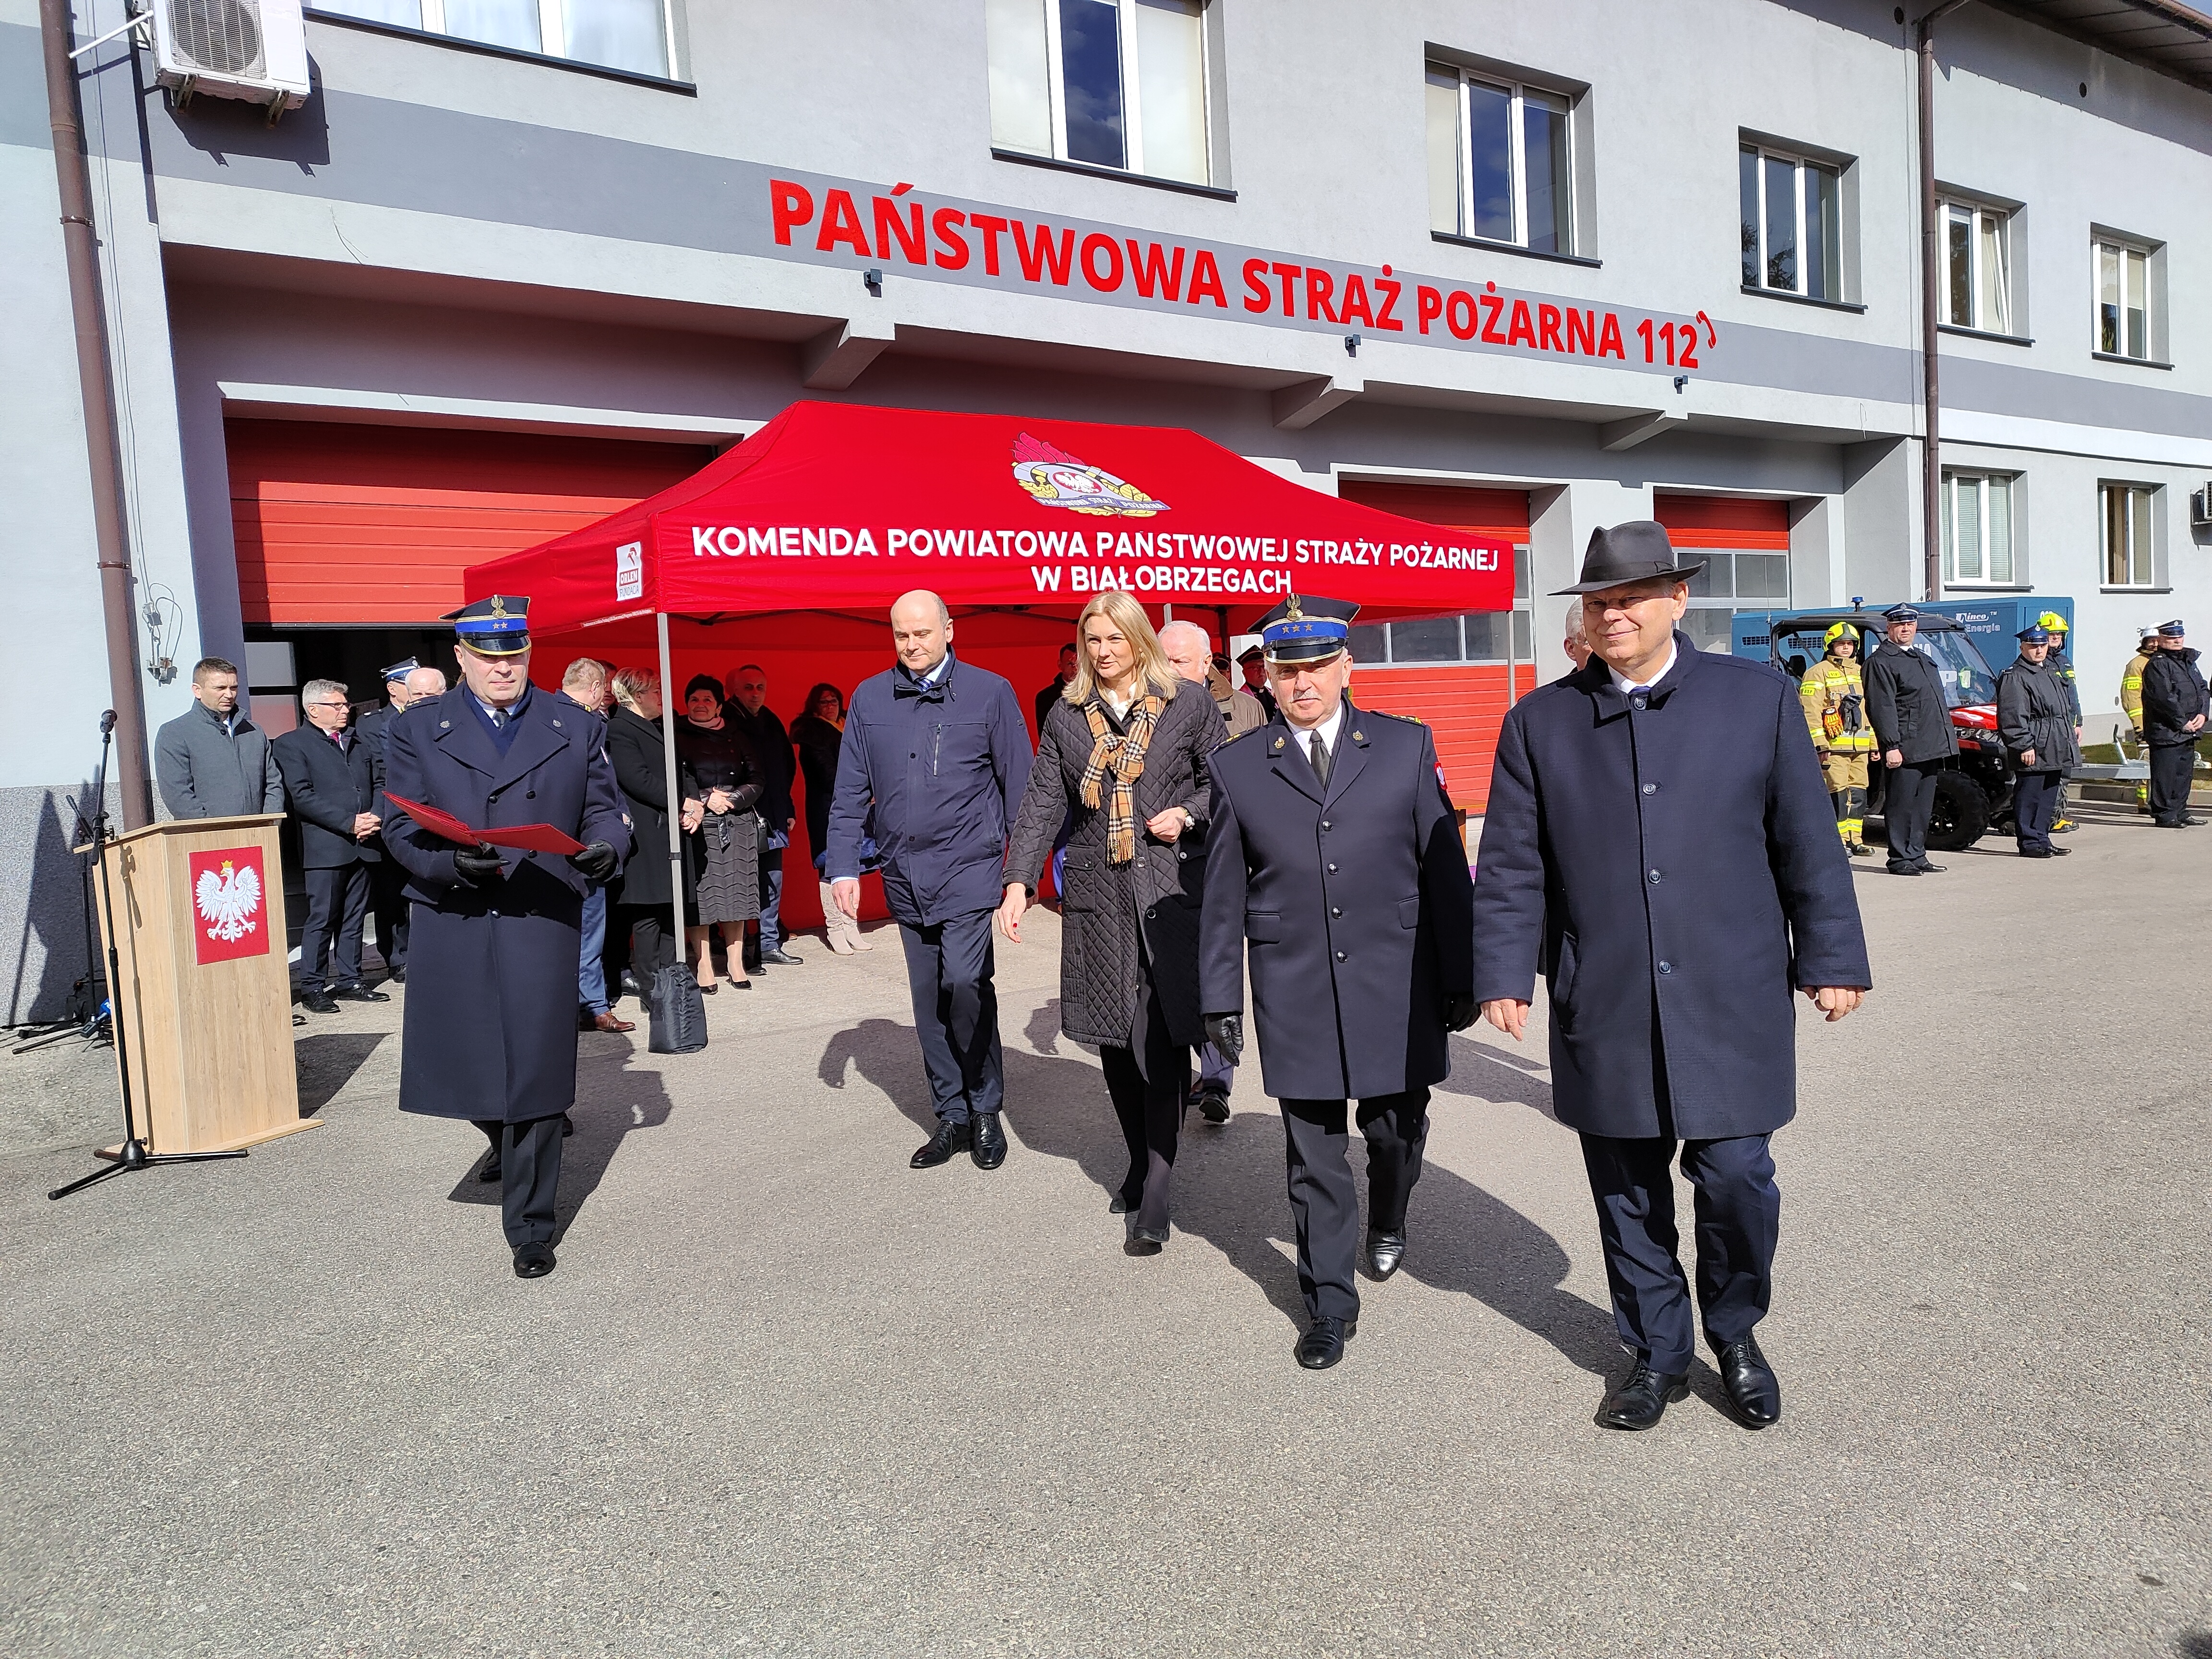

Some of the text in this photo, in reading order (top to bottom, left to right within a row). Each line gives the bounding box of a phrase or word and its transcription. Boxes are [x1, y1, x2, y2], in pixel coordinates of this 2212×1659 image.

[770, 180, 1698, 369] PAŃSTWOWA STRAŻ POŻARNA 112
[692, 527, 1499, 571] KOMENDA POWIATOWA PAŃSTWOWEJ STRAŻY POŻARNEJ
[620, 570, 637, 585] ORLEN
[1031, 565, 1292, 594] W BIAŁOBRZEGACH
